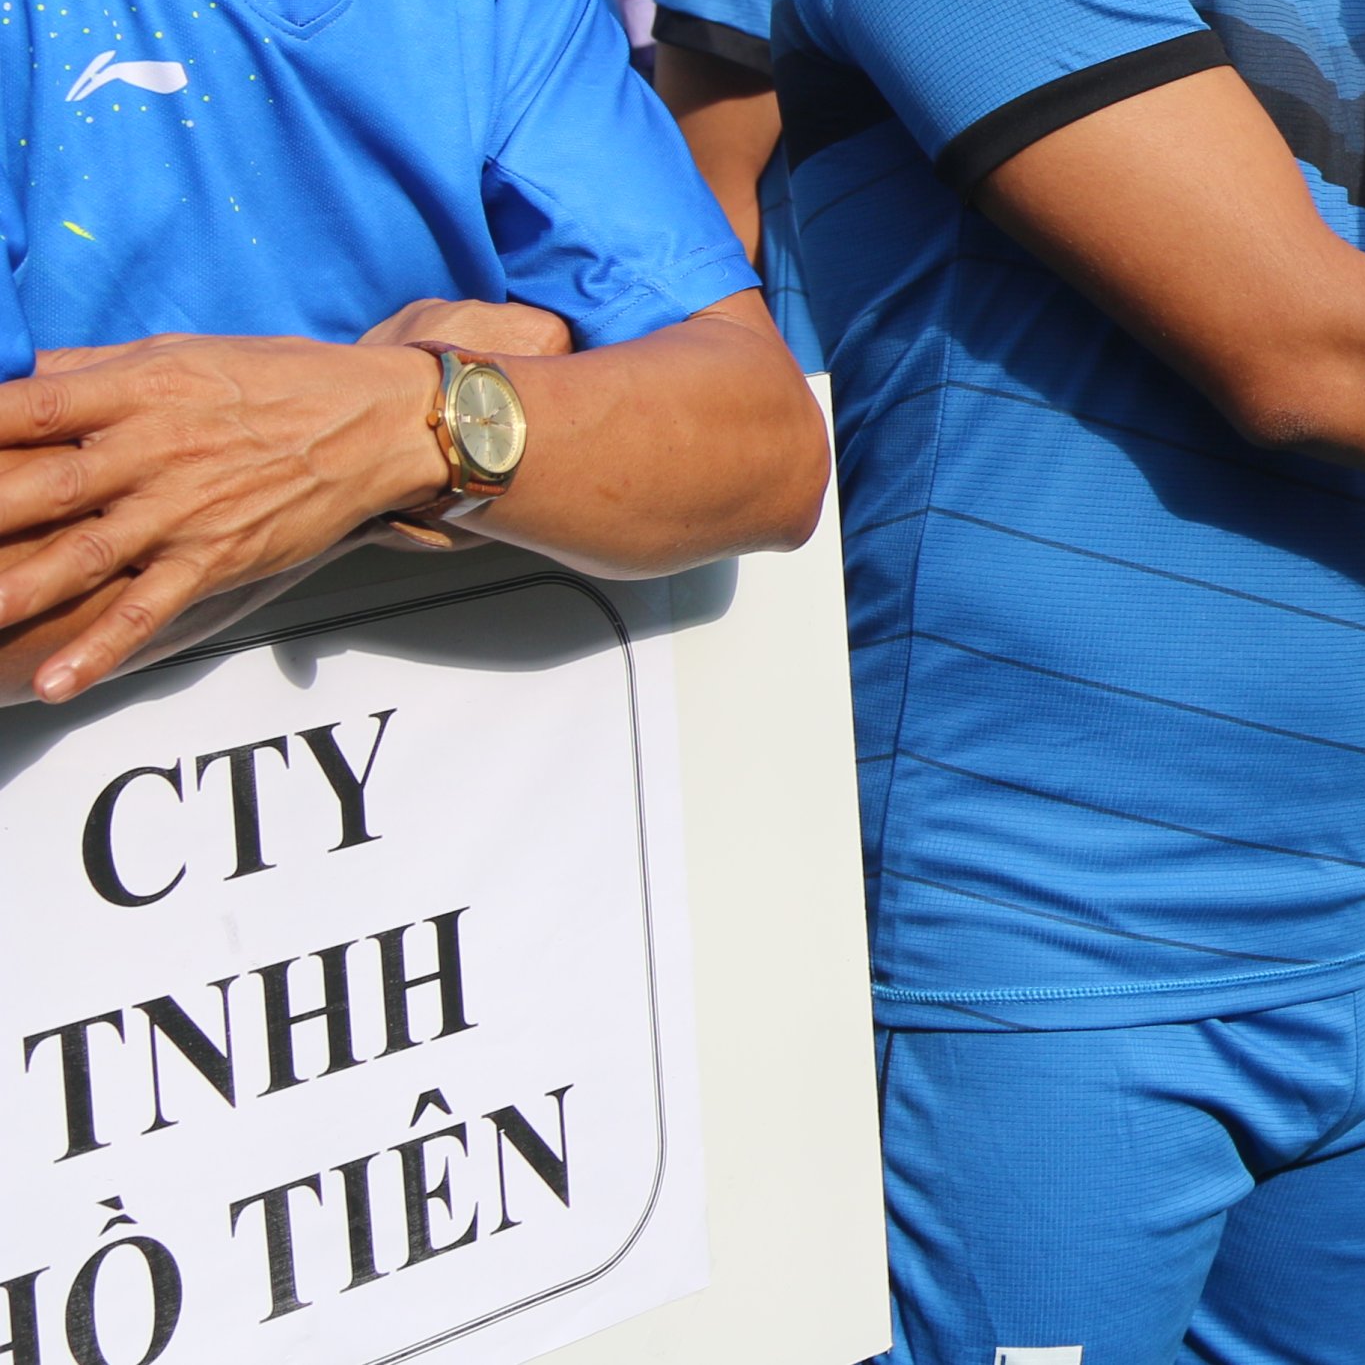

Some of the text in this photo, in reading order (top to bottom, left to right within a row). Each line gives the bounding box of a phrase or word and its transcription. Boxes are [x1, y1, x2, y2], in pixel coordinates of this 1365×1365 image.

[82, 708, 398, 909] CTY
[23, 906, 479, 1164] TNHH
[229, 1084, 575, 1325] TIÊN
